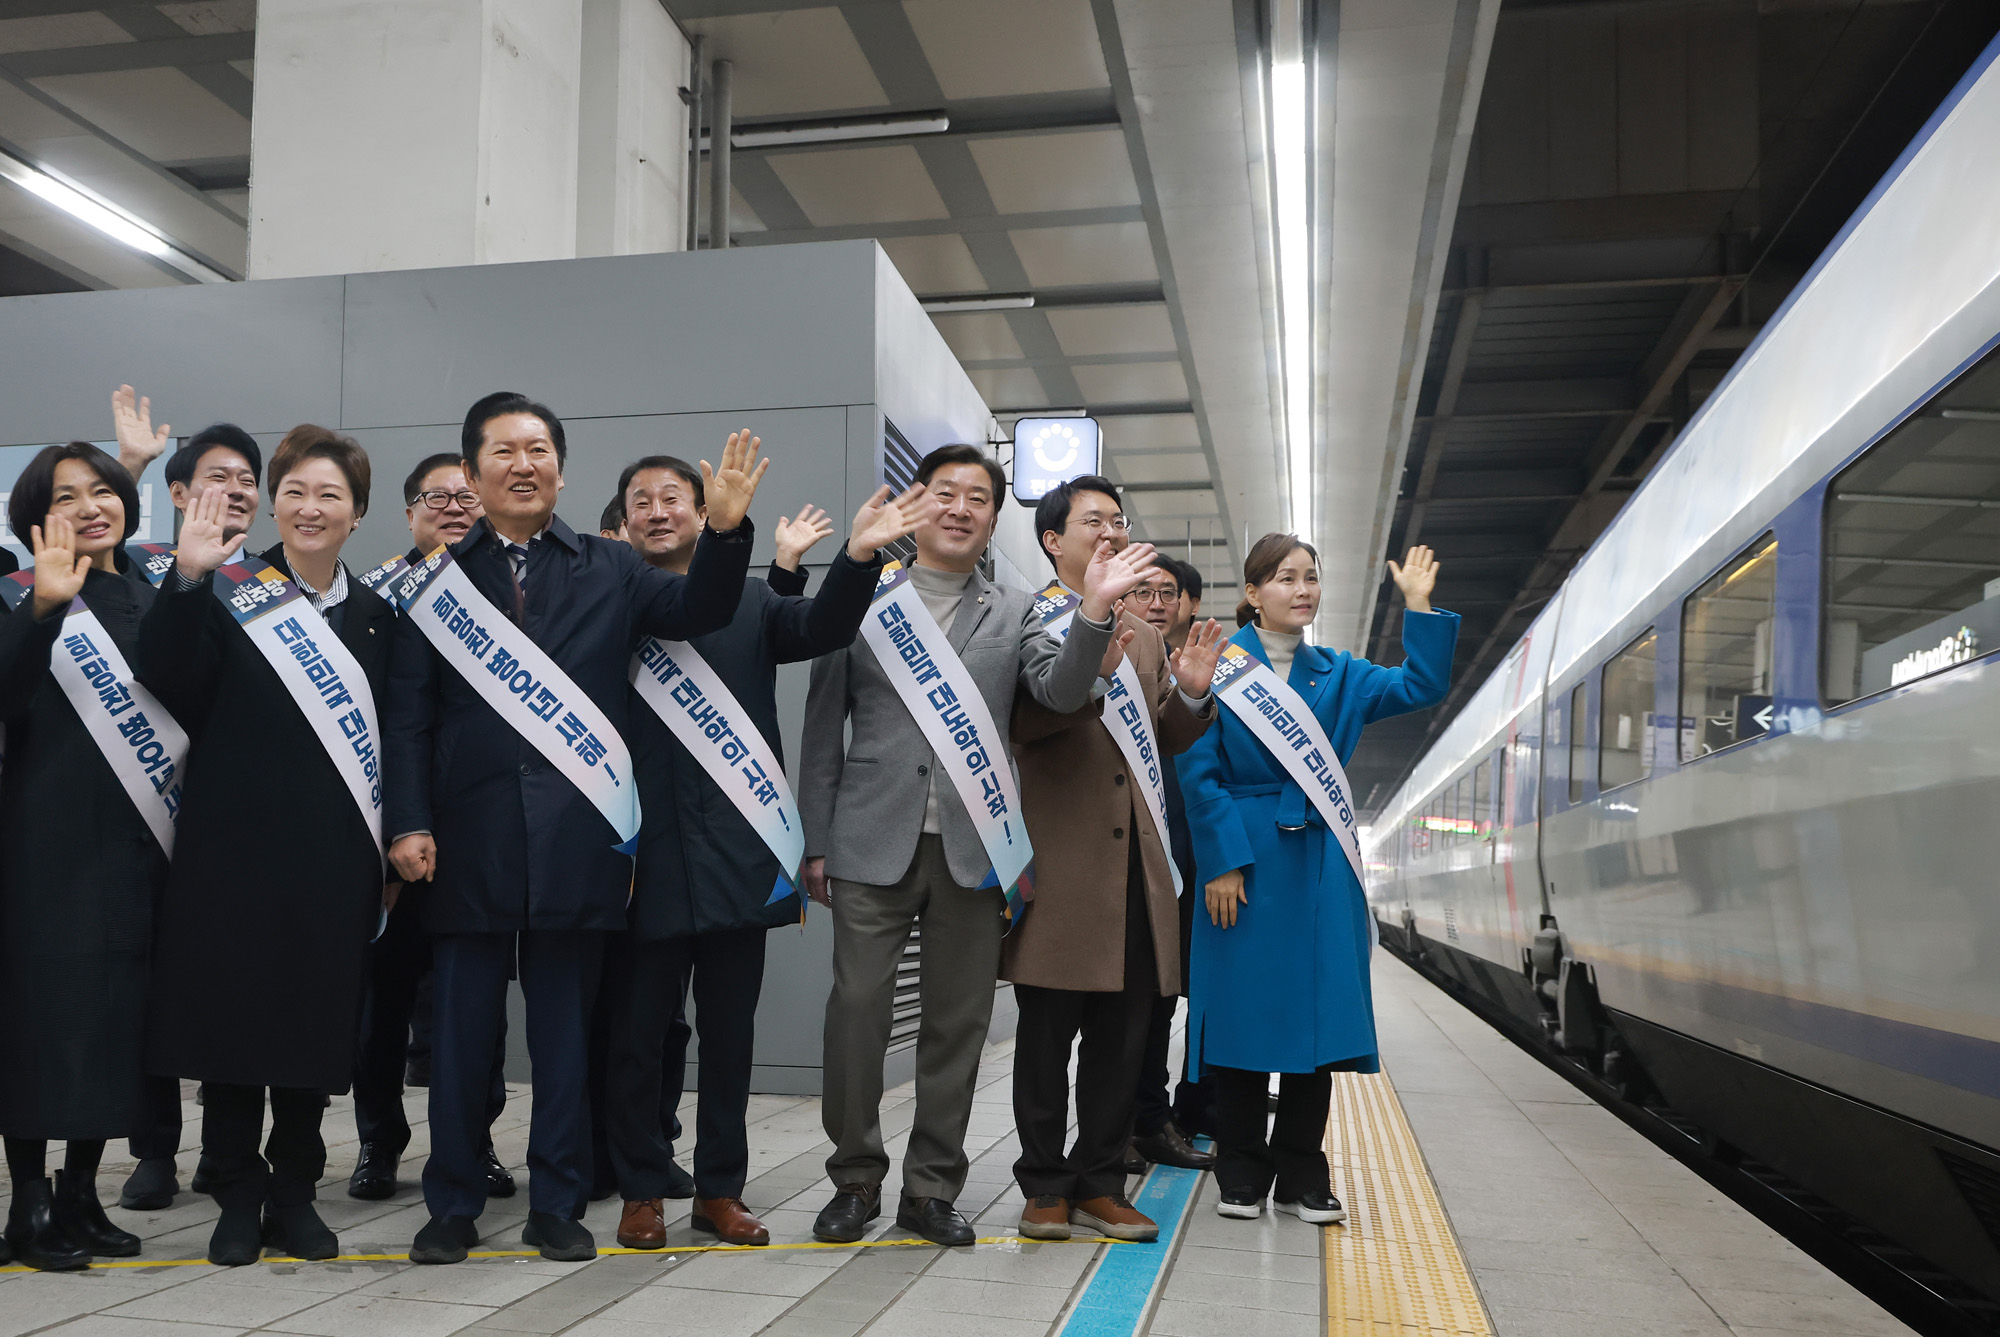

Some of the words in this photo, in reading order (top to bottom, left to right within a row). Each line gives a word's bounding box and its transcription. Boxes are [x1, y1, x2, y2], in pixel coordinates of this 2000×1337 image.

[230, 578, 287, 614] 민주당
[399, 553, 442, 600] 민주당
[64, 633, 136, 717] 희망찬
[432, 588, 495, 660] 희망찬
[486, 647, 564, 722] 병오년
[877, 601, 942, 686] 대한민국
[928, 681, 991, 777] 대도약의
[273, 617, 353, 710] 대한민국
[338, 707, 382, 811] 대도약의
[670, 676, 751, 768] 대도약의
[1118, 699, 1161, 789] 대도약의
[1242, 681, 1313, 751] 대한민국
[1304, 747, 1353, 828] 대도약의
